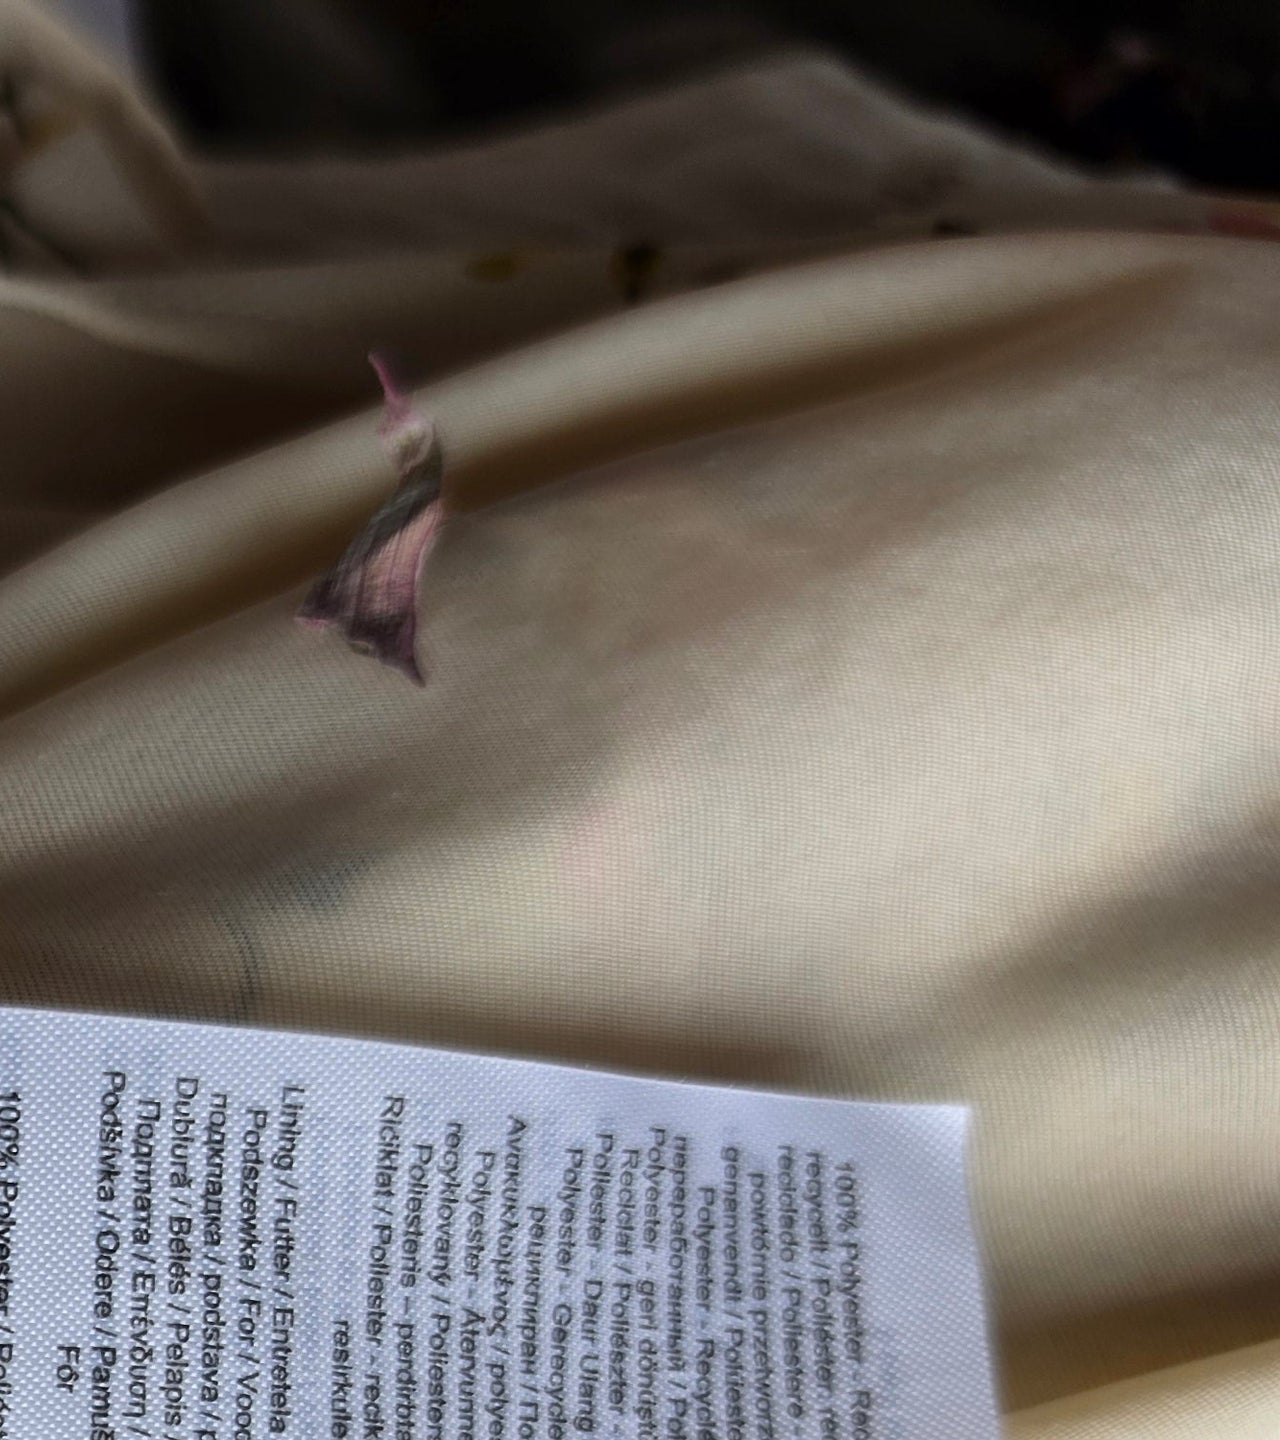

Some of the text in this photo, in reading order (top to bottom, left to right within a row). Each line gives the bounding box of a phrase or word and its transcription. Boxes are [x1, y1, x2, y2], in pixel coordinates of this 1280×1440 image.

[271, 1086, 303, 1171] Lining
[237, 1108, 266, 1271] Podszewka
[271, 1197, 295, 1281] Futter
[94, 1229, 117, 1319] Odere
[158, 1322, 188, 1426] Pelapis
[196, 1273, 226, 1402] podstava
[269, 1307, 294, 1433] Entretela
